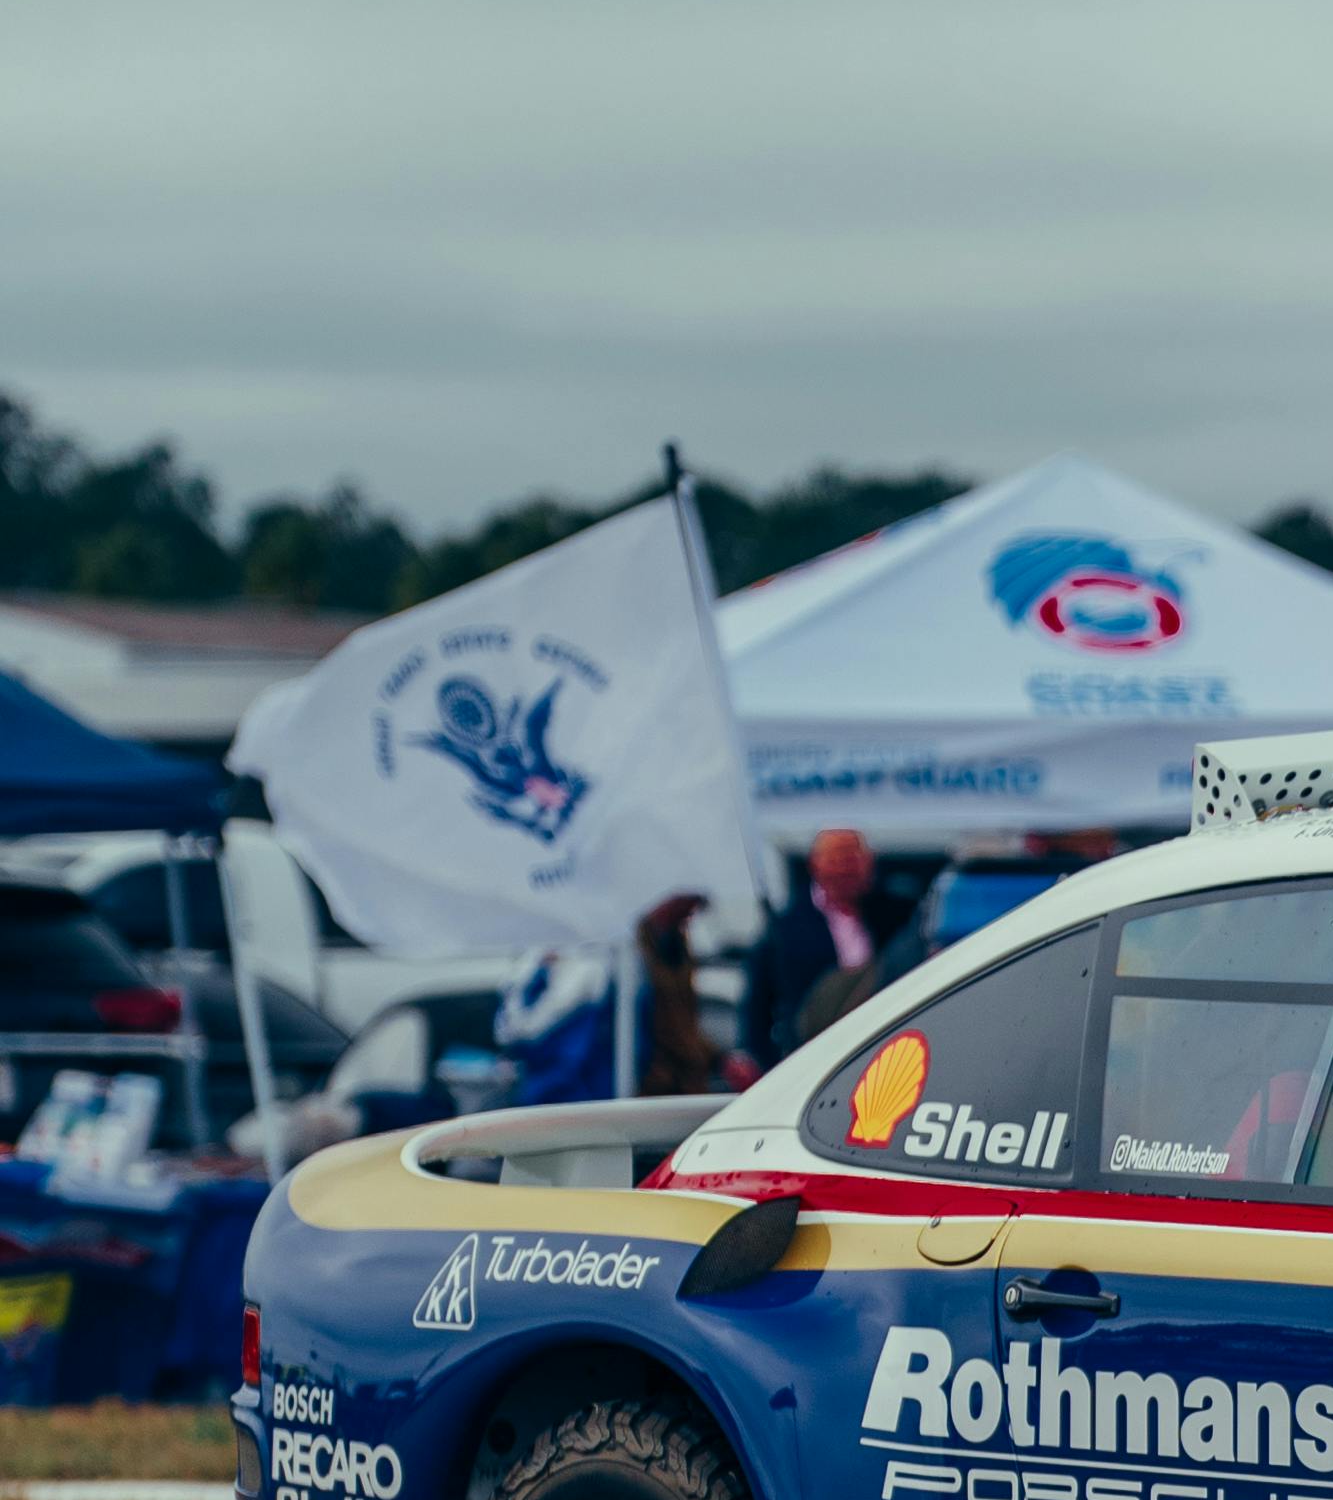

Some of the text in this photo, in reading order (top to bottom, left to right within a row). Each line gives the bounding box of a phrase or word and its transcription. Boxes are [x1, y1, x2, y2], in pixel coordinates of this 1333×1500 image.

[904, 1102, 1068, 1171] Shell
[484, 1236, 660, 1290] Turbolader
[273, 1383, 334, 1426] BOSCH
[272, 1429, 402, 1500] RECARO
